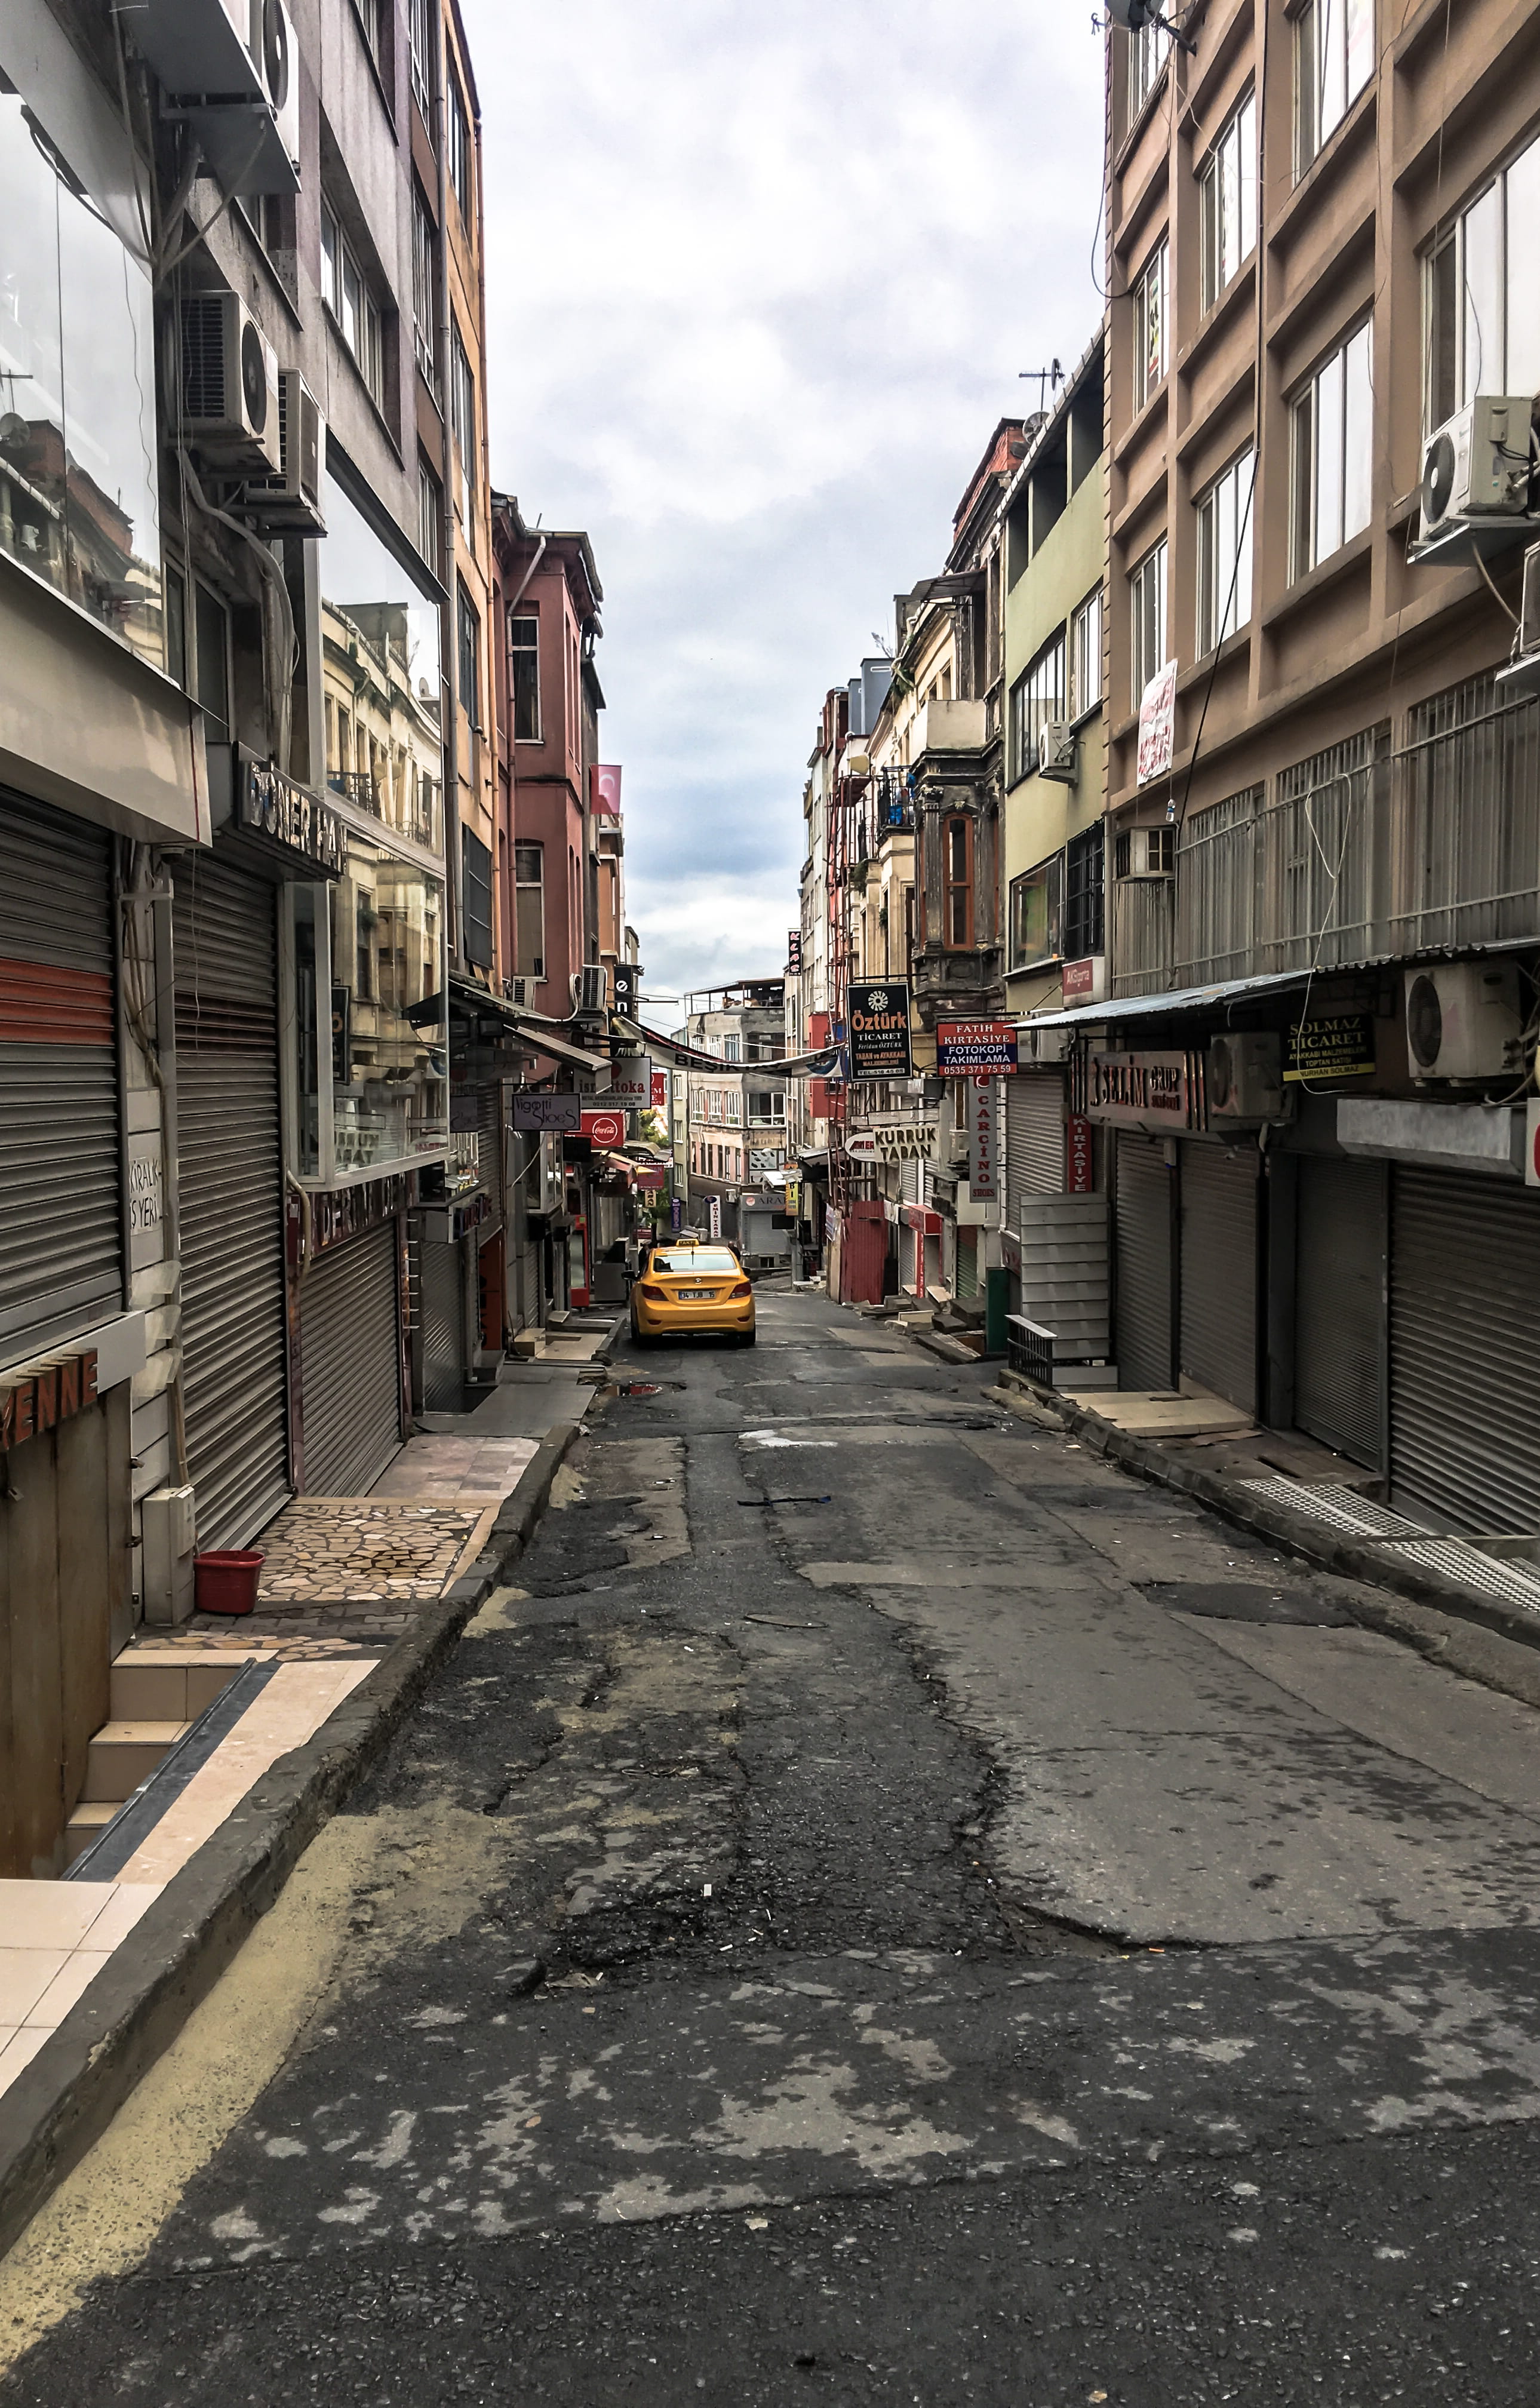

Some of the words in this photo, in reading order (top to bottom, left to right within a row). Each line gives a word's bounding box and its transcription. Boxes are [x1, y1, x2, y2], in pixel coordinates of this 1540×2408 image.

[852, 1010, 907, 1031] Öztürk
[1290, 1017, 1361, 1036] SOLMAZ
[957, 1024, 993, 1033] FATİH
[857, 1033, 902, 1041] TİCARET
[944, 1034, 1010, 1044] KIRTASİYE
[1287, 1032, 1365, 1050] TİCARET
[949, 1043, 1006, 1055] FOTOKOPİ
[1289, 1051, 1320, 1060] AYAKKABI
[944, 1055, 1010, 1064] TAKIMLAMA
[1149, 1066, 1178, 1092] GRUP
[875, 1127, 936, 1145] KURRUK
[1073, 1119, 1086, 1191] KIRTASİYE
[973, 1188, 995, 1197] SHOES
[139, 1193, 157, 1227] YERİ
